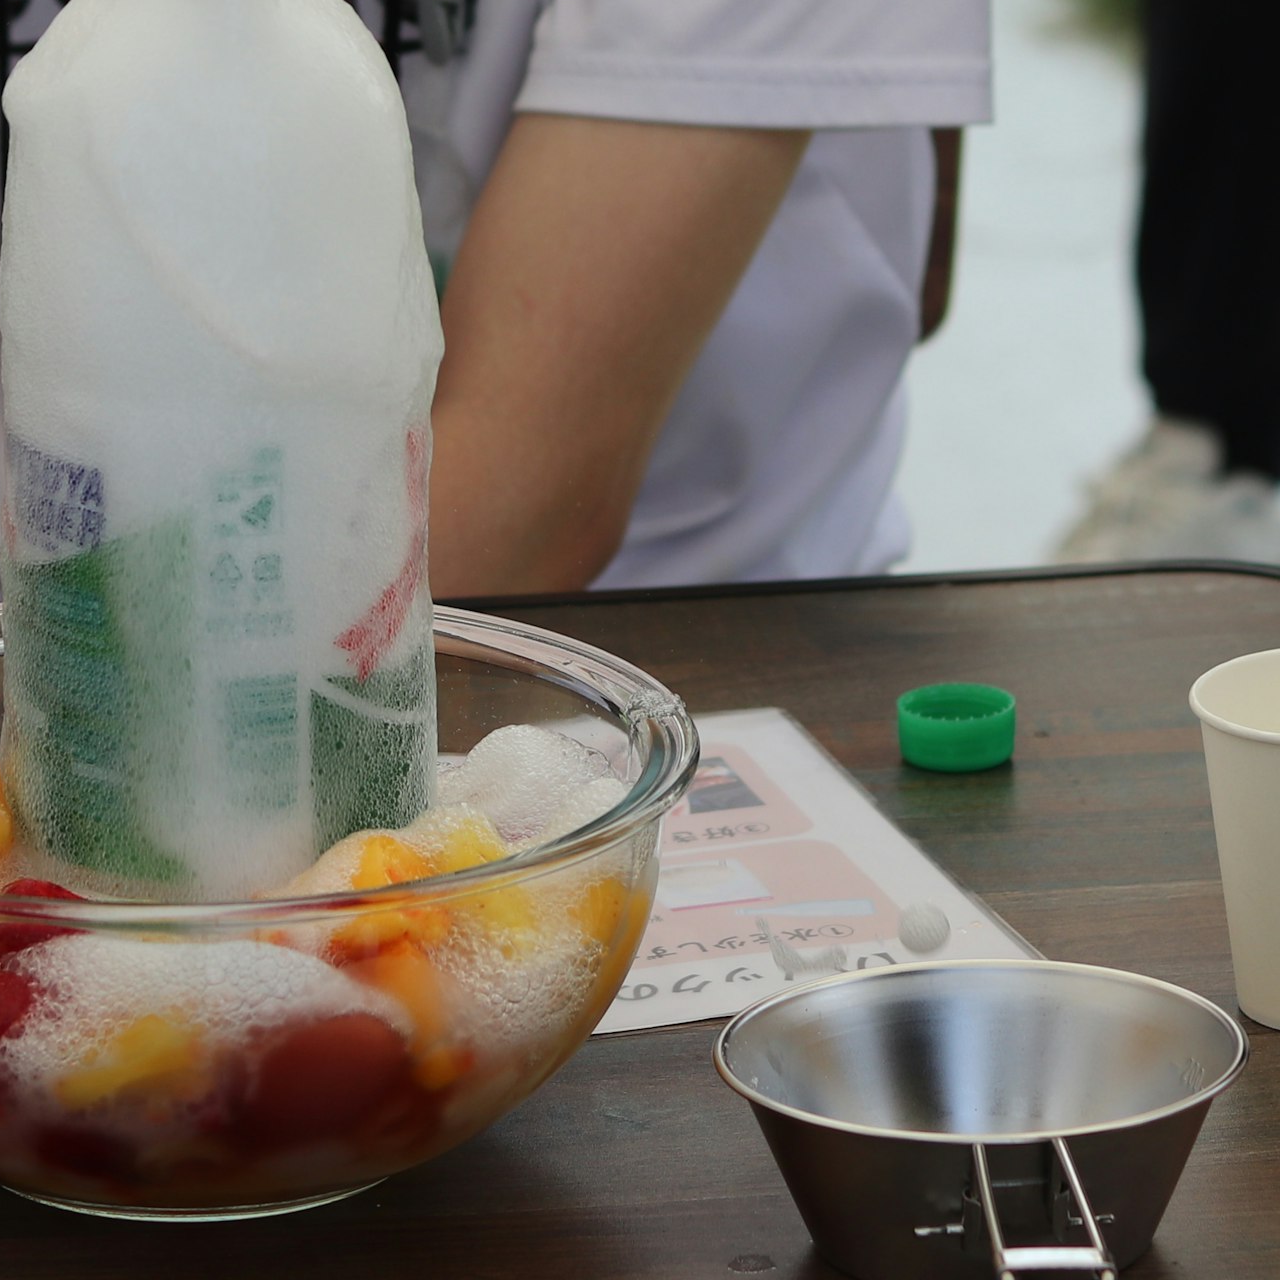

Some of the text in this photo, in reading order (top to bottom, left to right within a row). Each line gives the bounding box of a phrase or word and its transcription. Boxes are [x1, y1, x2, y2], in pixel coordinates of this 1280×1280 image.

[635, 923, 855, 961] ①水を少しず
